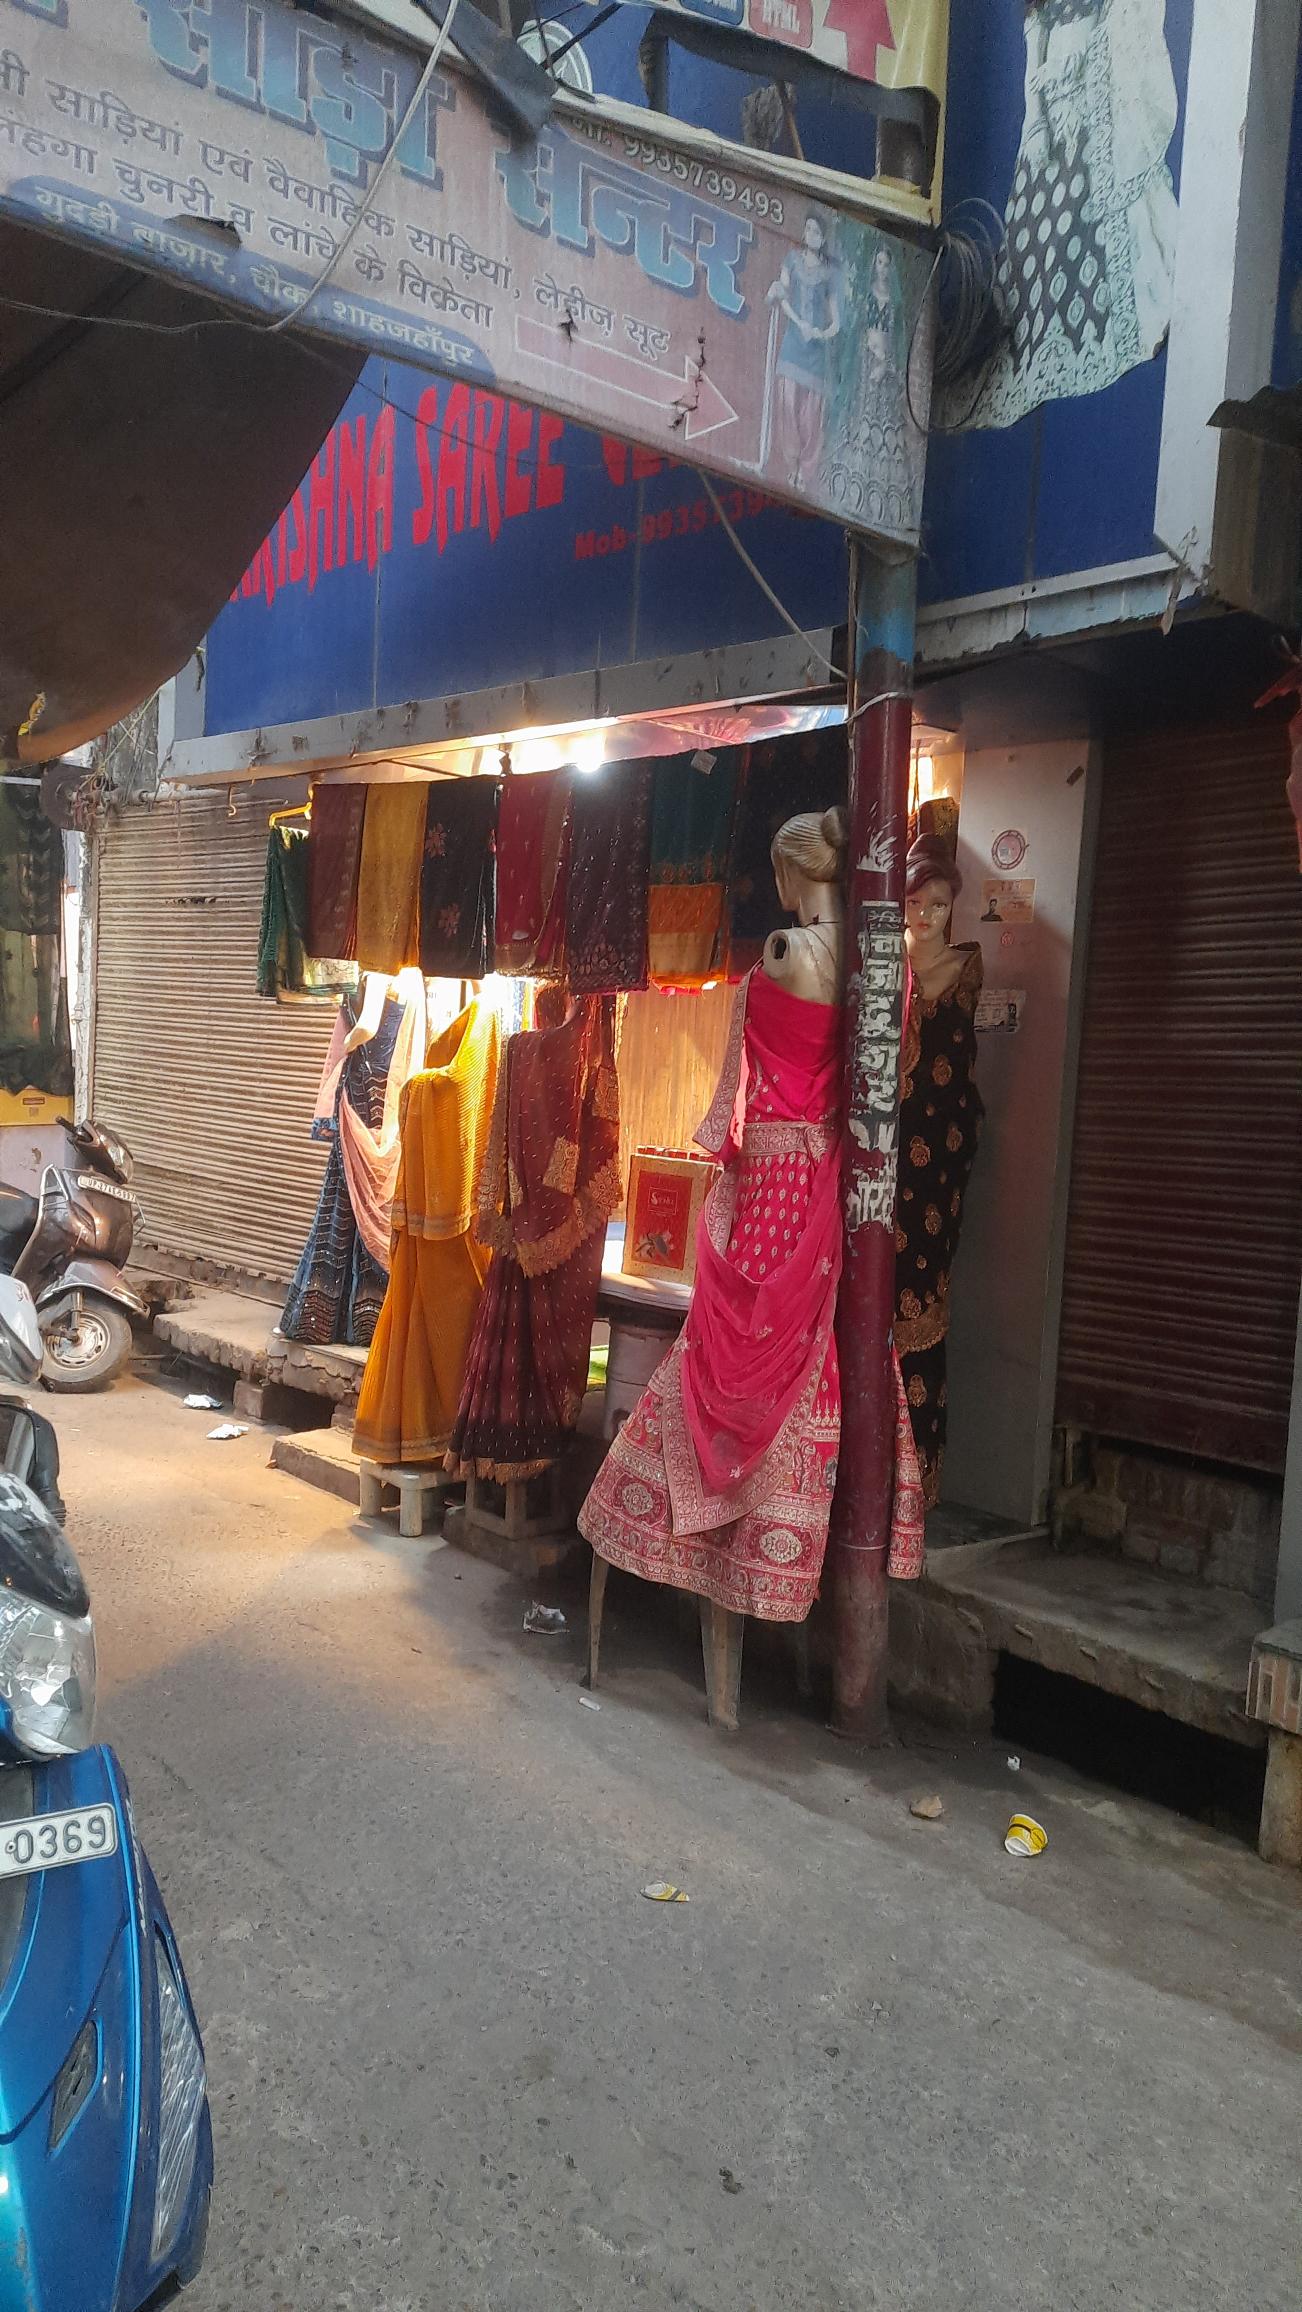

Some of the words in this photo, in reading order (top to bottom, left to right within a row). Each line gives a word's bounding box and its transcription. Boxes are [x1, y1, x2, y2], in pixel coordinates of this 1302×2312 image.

[112, 157, 215, 217] चुनरी
[227, 201, 256, 233] व
[353, 243, 387, 283] के
[398, 258, 494, 328] विक्रेता
[199, 140, 254, 183] एवं
[262, 157, 396, 236] वैवाहिक
[622, 314, 671, 360] सूट
[623, 134, 785, 226] 9935739493
[412, 382, 564, 557] SAREE
[13, 1815, 106, 1864] 0369
